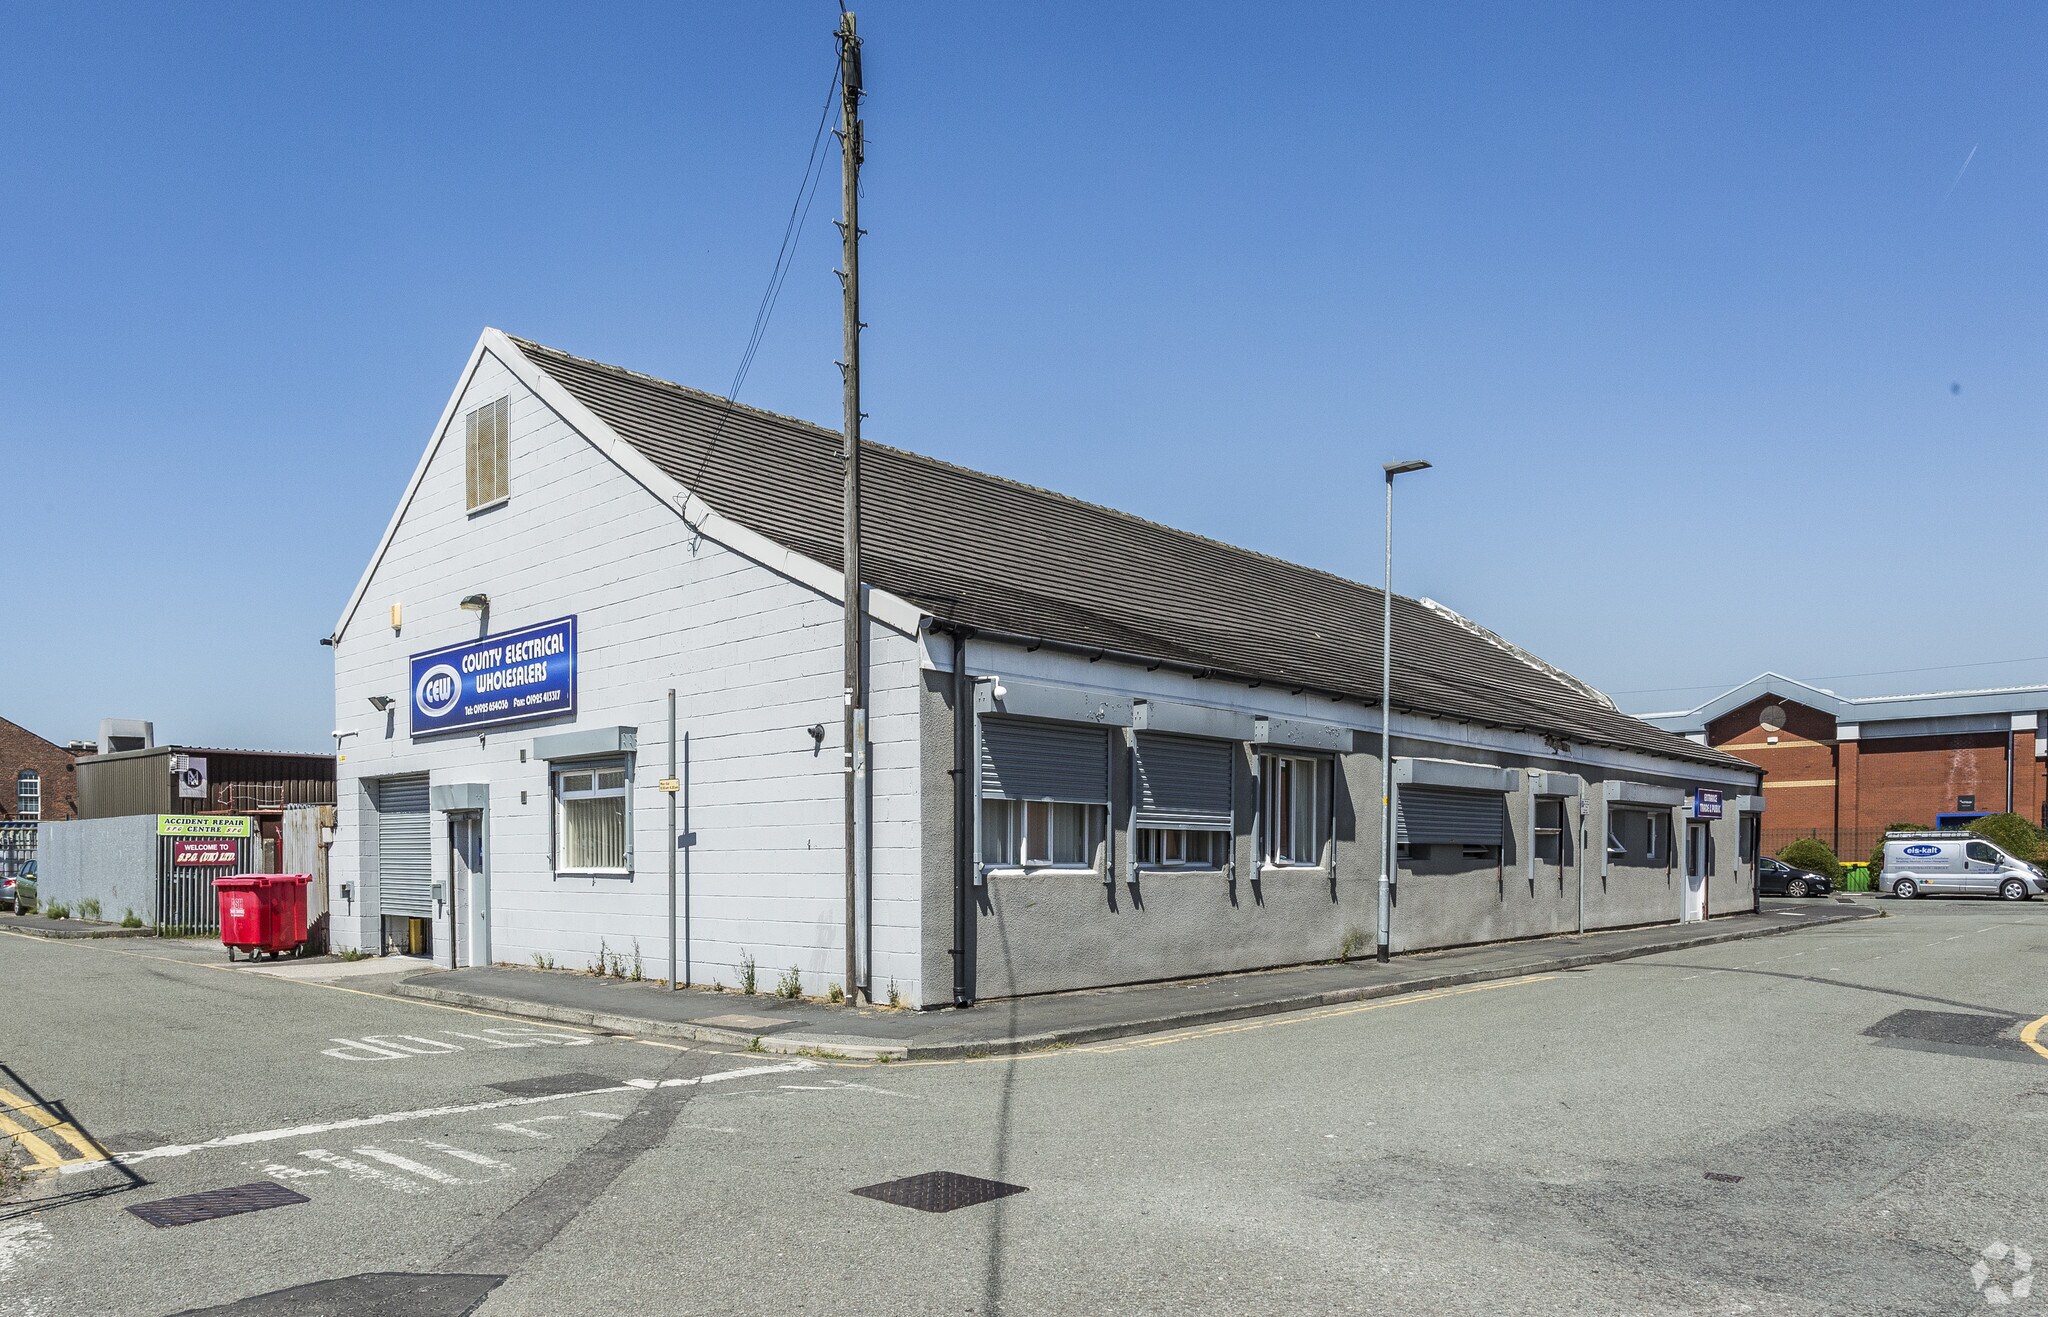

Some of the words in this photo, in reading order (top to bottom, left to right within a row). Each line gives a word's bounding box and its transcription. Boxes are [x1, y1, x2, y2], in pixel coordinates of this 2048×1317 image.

[462, 647, 502, 673] COUNTY
[506, 633, 564, 663] ELECTRICAL
[425, 676, 451, 703] CEW
[476, 662, 547, 693] WHOLESALERS
[473, 703, 489, 715] 01925
[489, 699, 508, 712] 654036
[513, 697, 526, 708] Fax:
[525, 694, 543, 706] 01925
